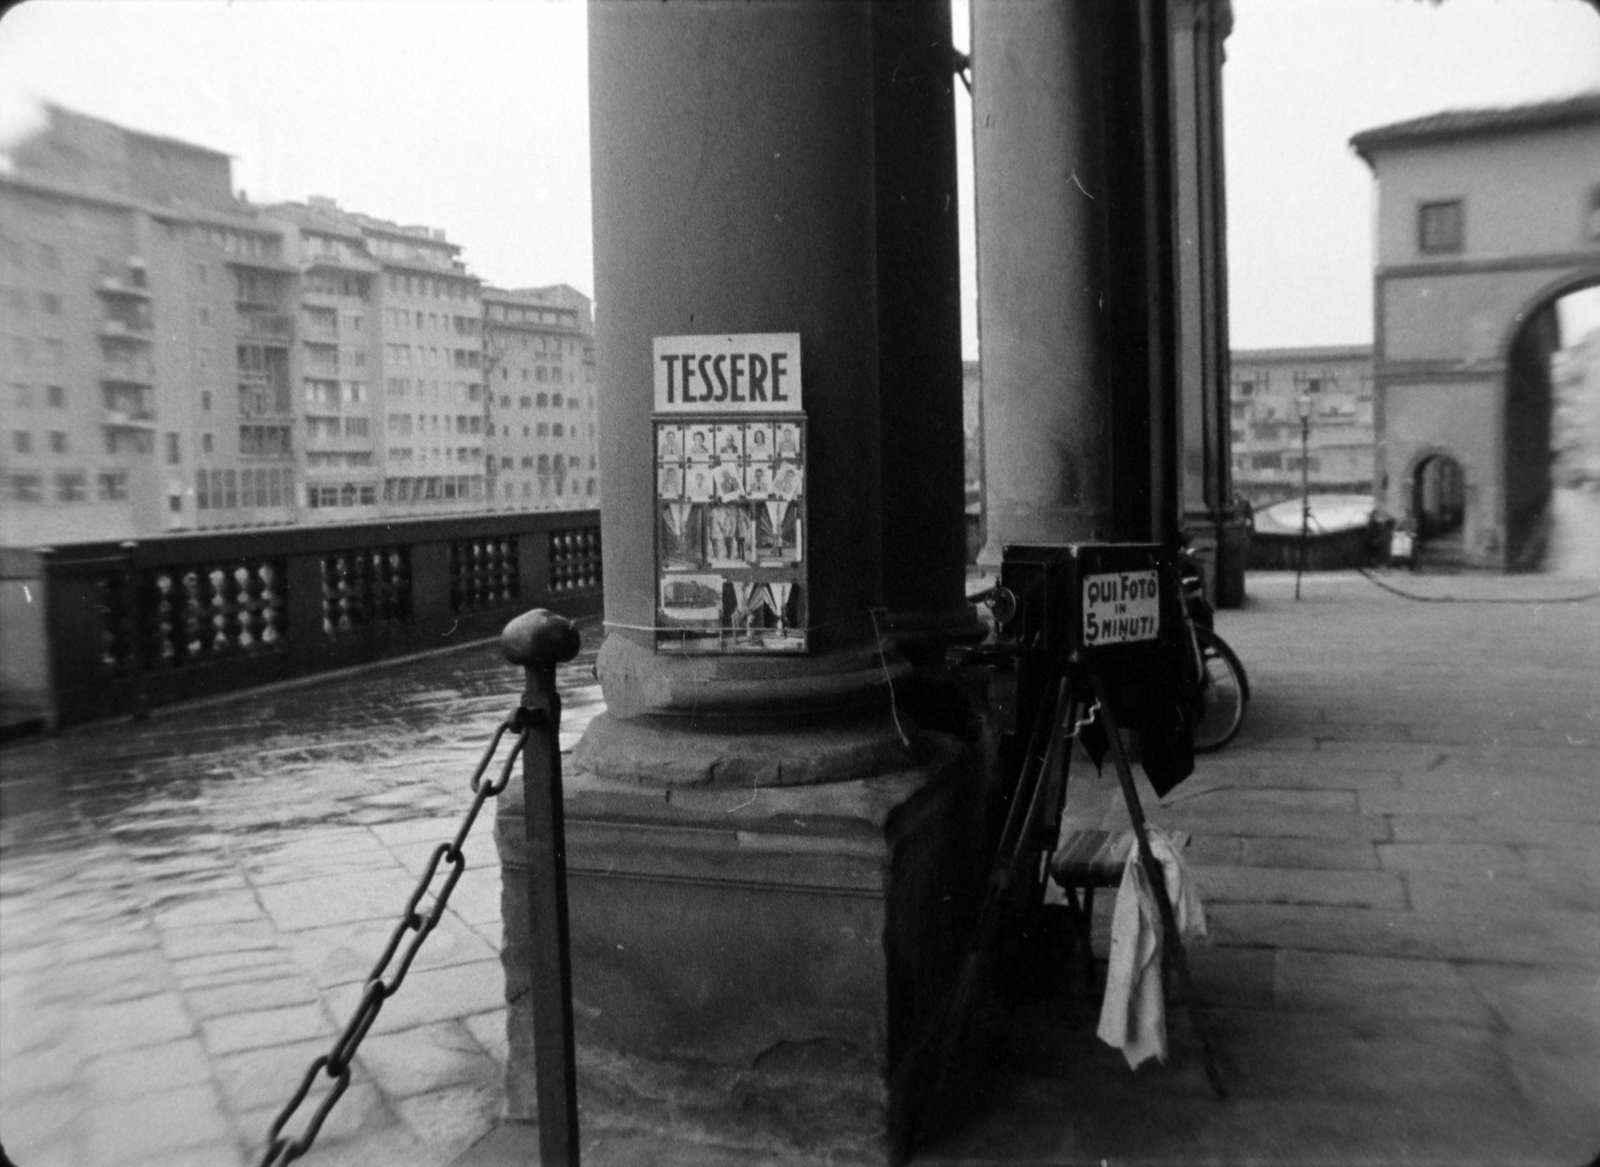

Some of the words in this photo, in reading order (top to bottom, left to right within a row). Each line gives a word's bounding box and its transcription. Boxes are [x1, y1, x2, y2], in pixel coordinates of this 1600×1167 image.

[660, 352, 788, 403] TESSERE
[1087, 581, 1117, 608] QUI
[1115, 603, 1126, 614] IN
[1085, 612, 1099, 641] 5
[1101, 616, 1154, 638] MINUTI
